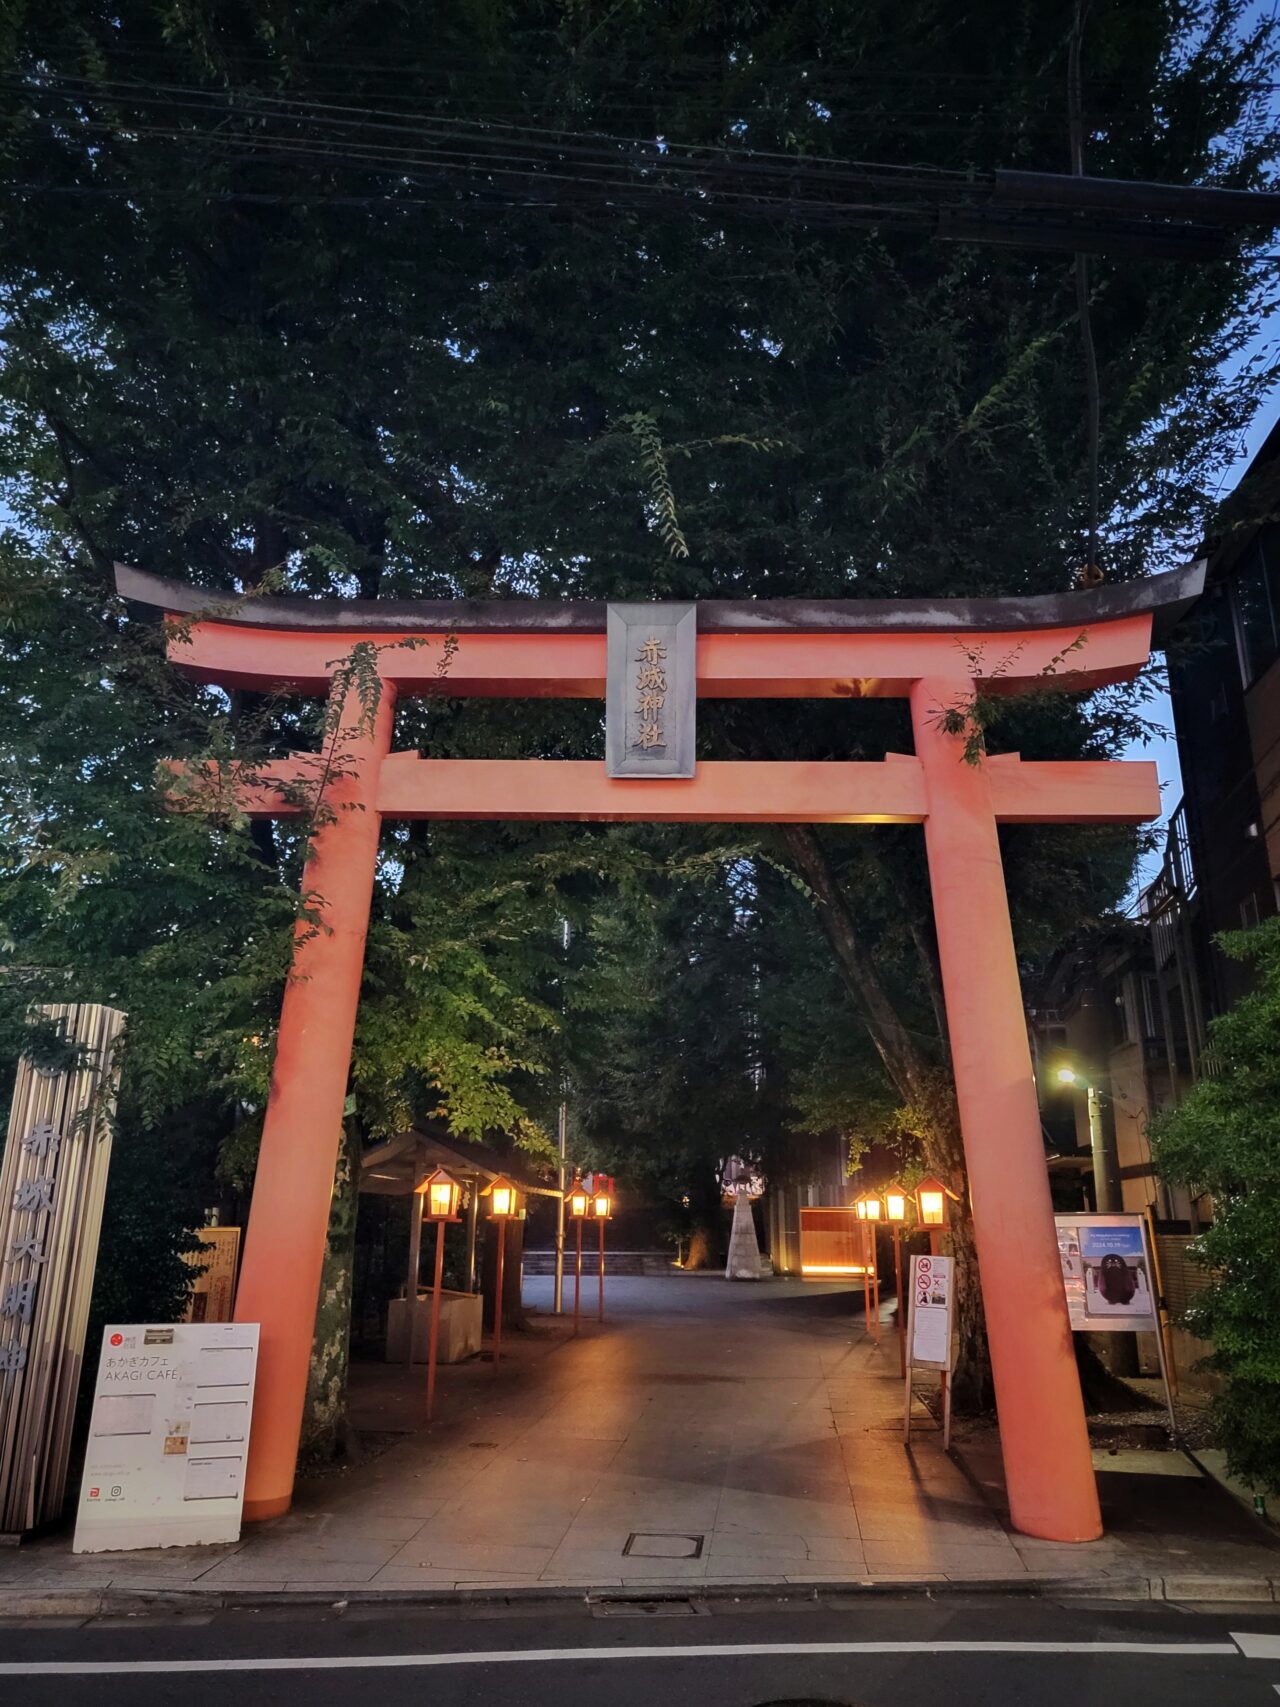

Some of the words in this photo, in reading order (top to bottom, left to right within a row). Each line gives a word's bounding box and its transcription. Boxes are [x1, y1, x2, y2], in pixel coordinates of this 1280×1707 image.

[634, 636, 668, 750] 赤城神社
[106, 1356, 169, 1368] あかぎカフェ
[105, 1370, 143, 1381] AKAGI
[147, 1369, 177, 1381] CAFE
